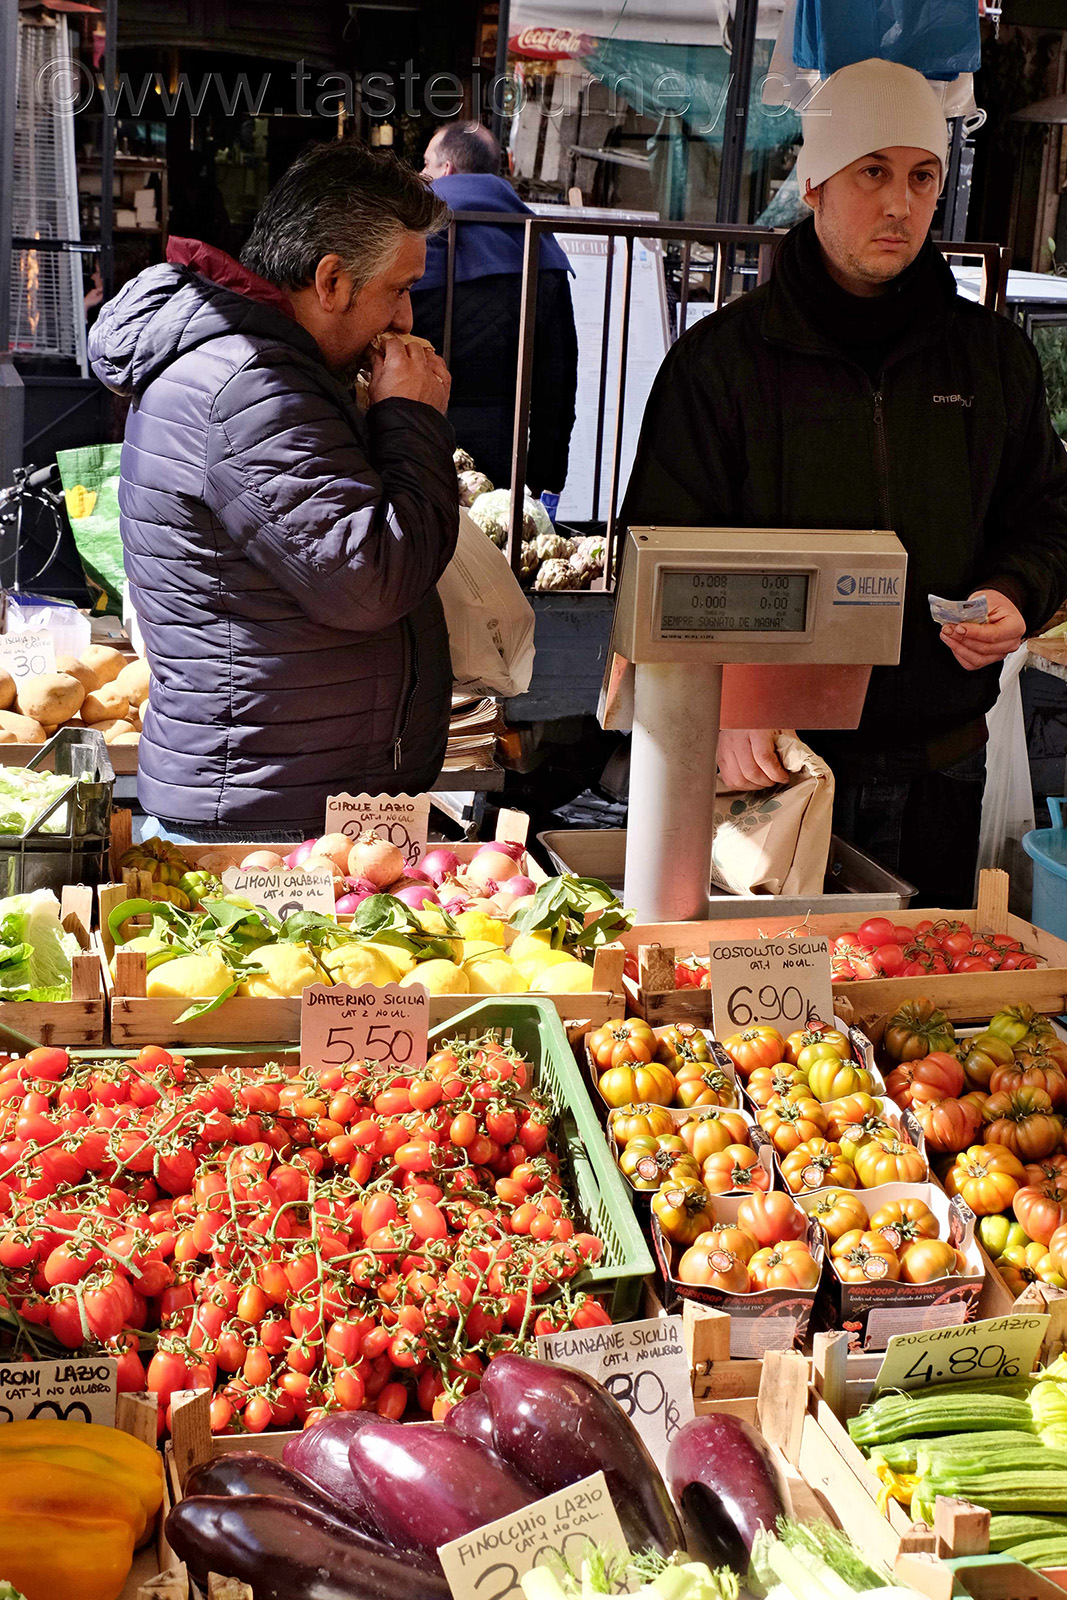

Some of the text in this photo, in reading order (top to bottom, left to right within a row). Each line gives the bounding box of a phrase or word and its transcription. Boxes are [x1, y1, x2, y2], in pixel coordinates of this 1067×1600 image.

[518, 25, 581, 53] Coca-Cola
[761, 576, 790, 589] 0,00
[858, 576, 900, 595] HELMAC
[691, 595, 727, 609] 0,000
[760, 597, 788, 610] 0,00
[662, 615, 694, 627] SEMPRE
[698, 616, 735, 627] SOGNATO
[739, 617, 750, 627] DE
[329, 801, 415, 812] CIPOLLE LAZIO
[234, 874, 332, 890] LIMONI CALABRIA
[712, 941, 828, 960] COSTOLUTO SICILIA
[306, 991, 426, 1007] DATTERINO SICILIA
[341, 1009, 357, 1019] CAT
[361, 1009, 369, 1018] 2
[674, 1286, 723, 1302] AGRICOOP
[724, 1296, 775, 1305] PACHINESE
[847, 1285, 946, 1296] AGRICOOP PACHINESE
[895, 1325, 982, 1347] ZUCCHINA
[988, 1318, 1041, 1332] LAZIO
[544, 1331, 625, 1361] MELANZANE
[54, 1365, 110, 1382] LAZIO
[46, 1387, 64, 1396] NO
[457, 1488, 603, 1567] FINOCCHIO LAZIO
[553, 1521, 571, 1536] NO
